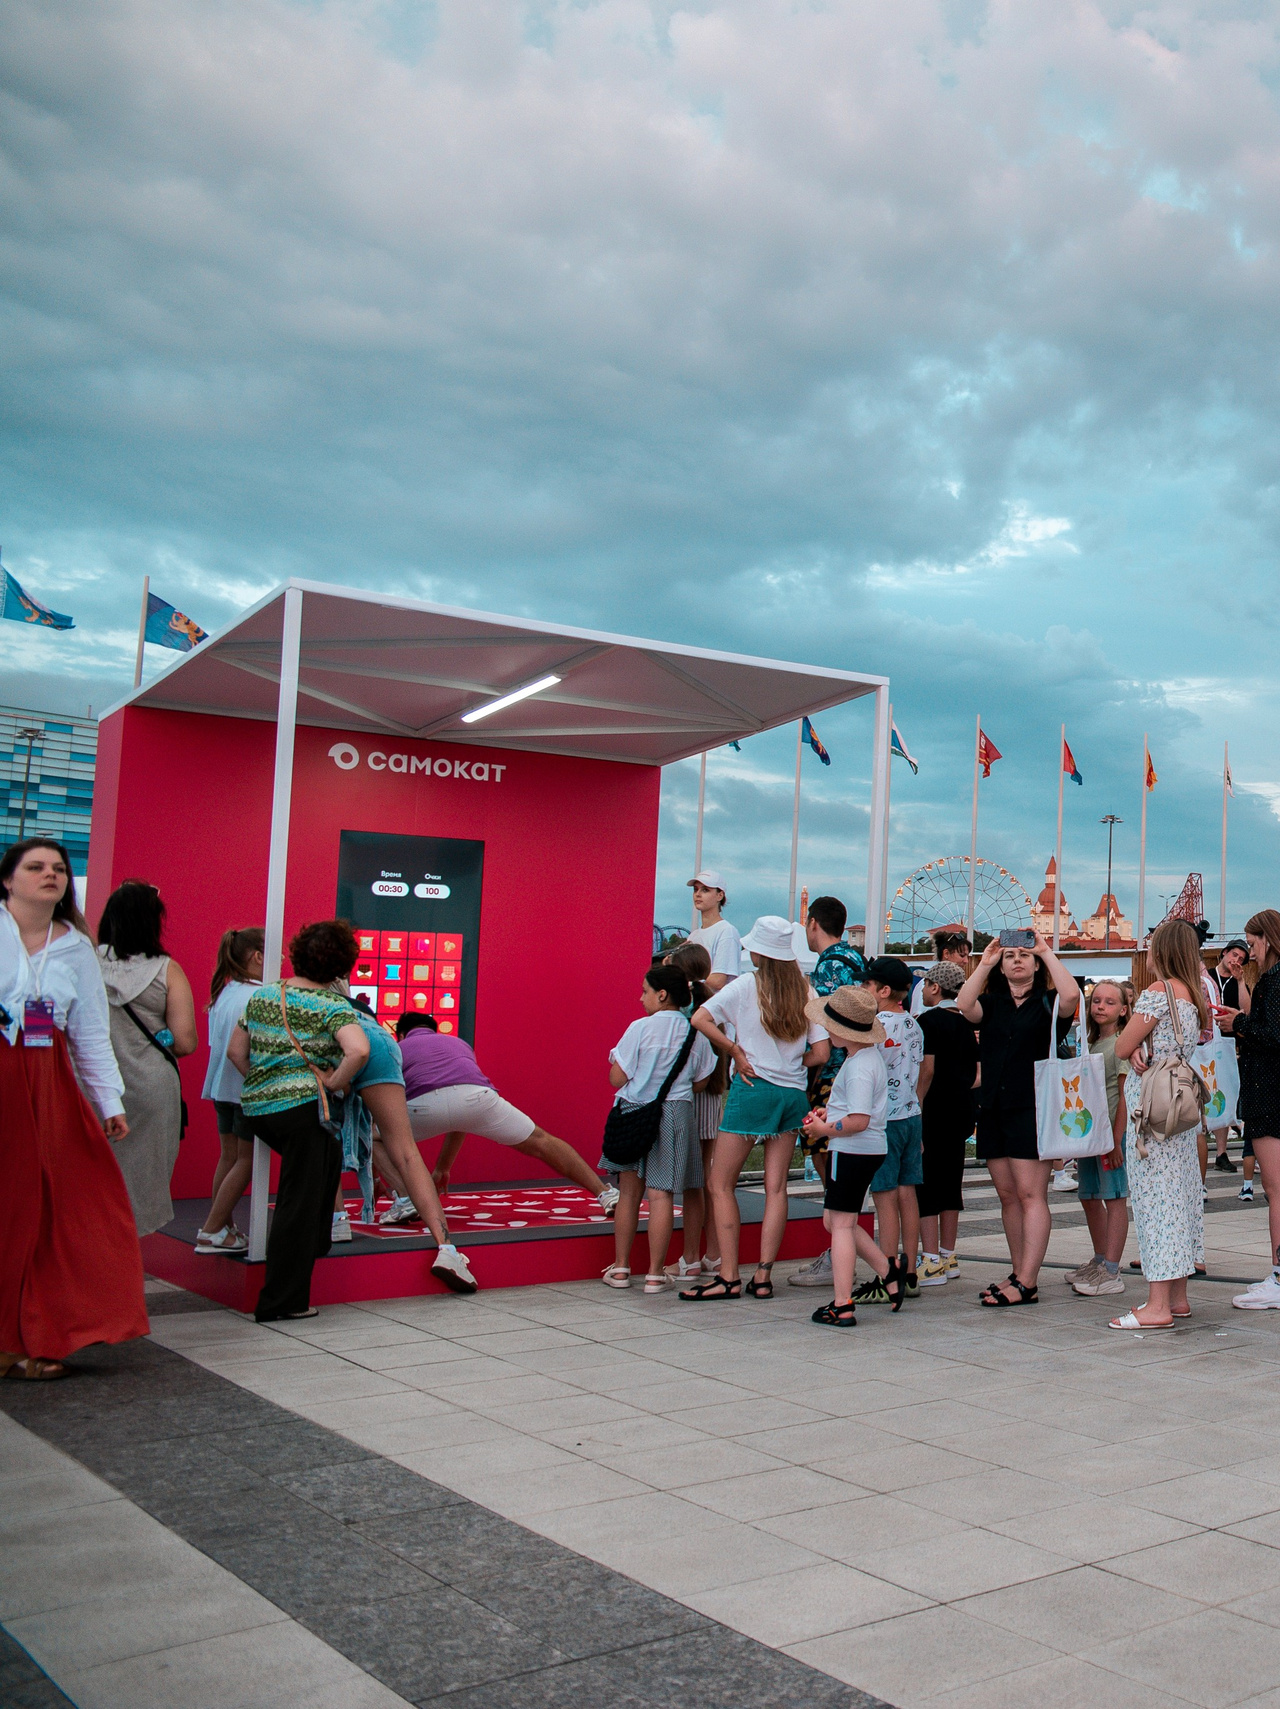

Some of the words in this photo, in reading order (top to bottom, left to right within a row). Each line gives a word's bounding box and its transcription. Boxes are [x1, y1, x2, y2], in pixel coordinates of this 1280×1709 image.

[367, 751, 507, 783] самокат
[378, 884, 403, 893] 00:30
[425, 887, 440, 895] 100
